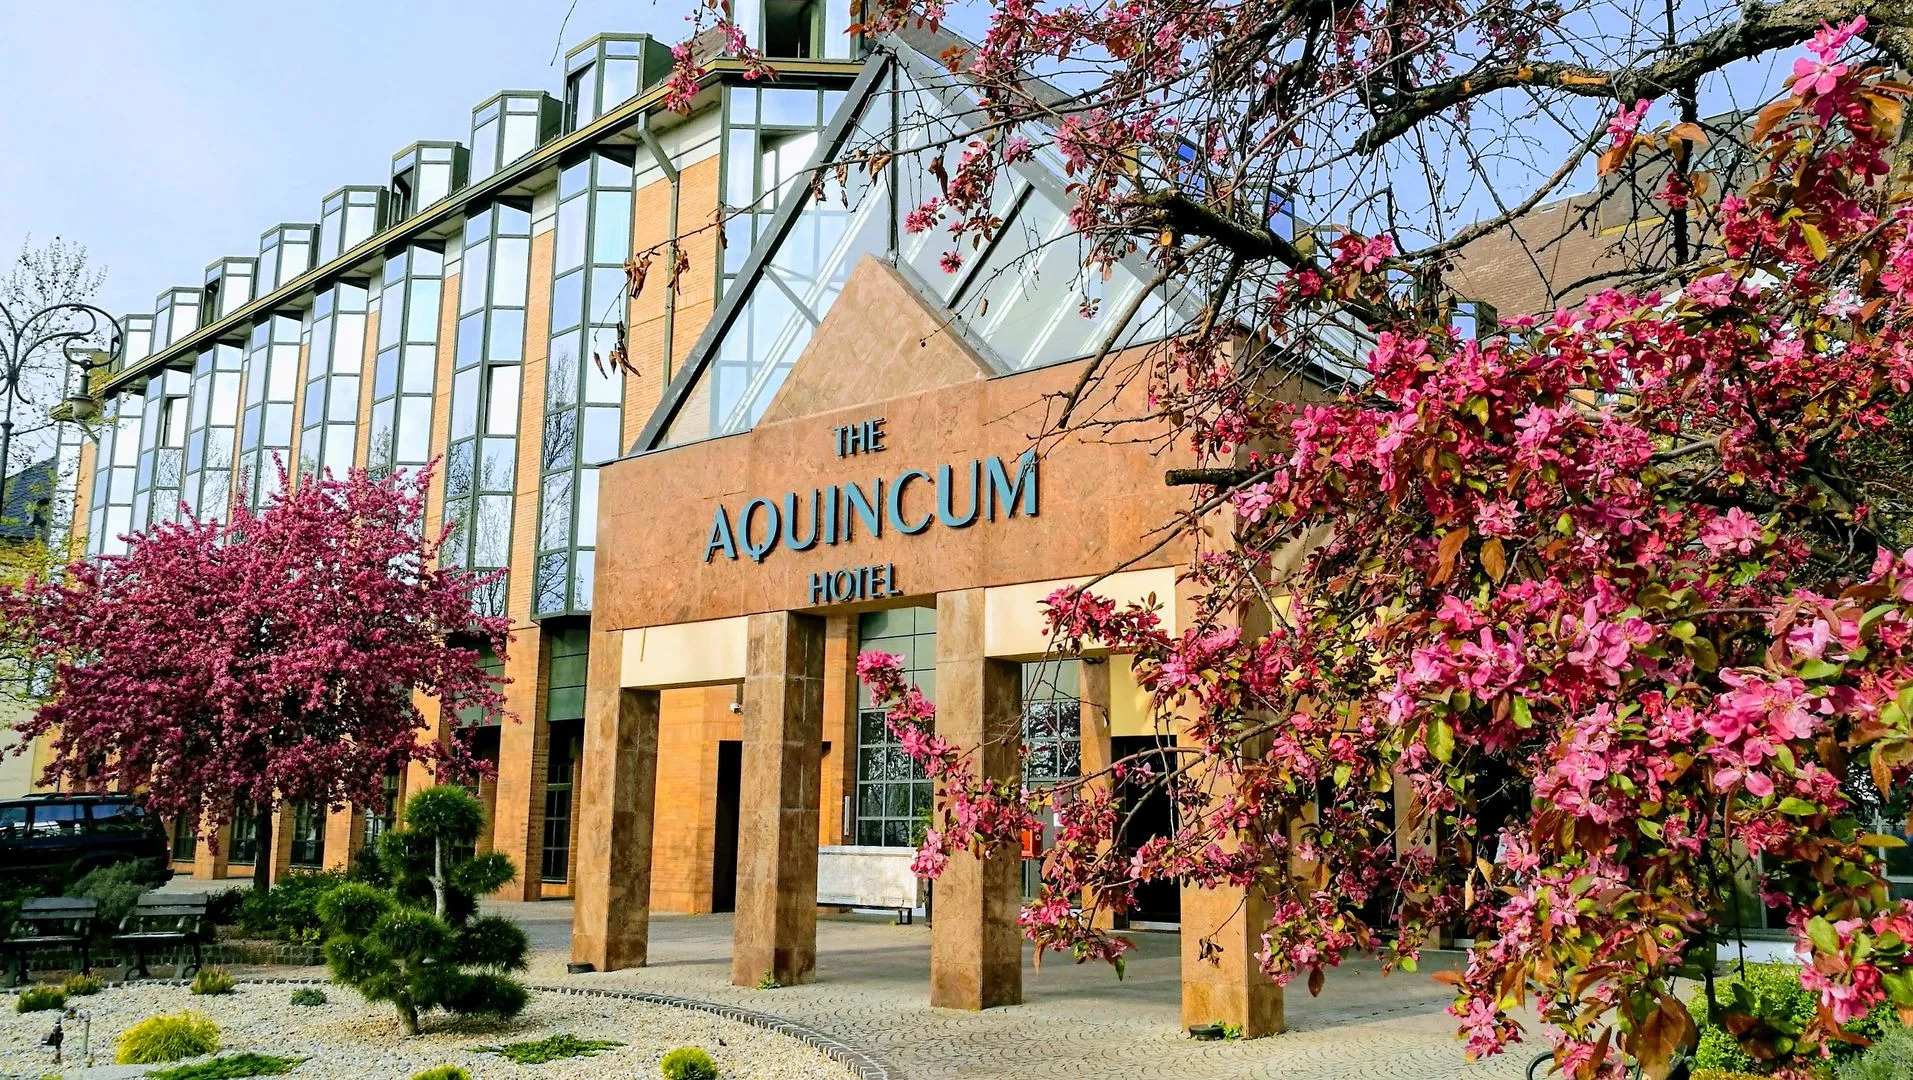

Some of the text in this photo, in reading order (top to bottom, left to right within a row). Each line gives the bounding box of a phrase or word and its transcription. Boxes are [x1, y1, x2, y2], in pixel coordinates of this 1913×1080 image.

[834, 418, 886, 457] THE
[704, 451, 1039, 562] AQUINCUM
[810, 563, 902, 604] HOTEL
